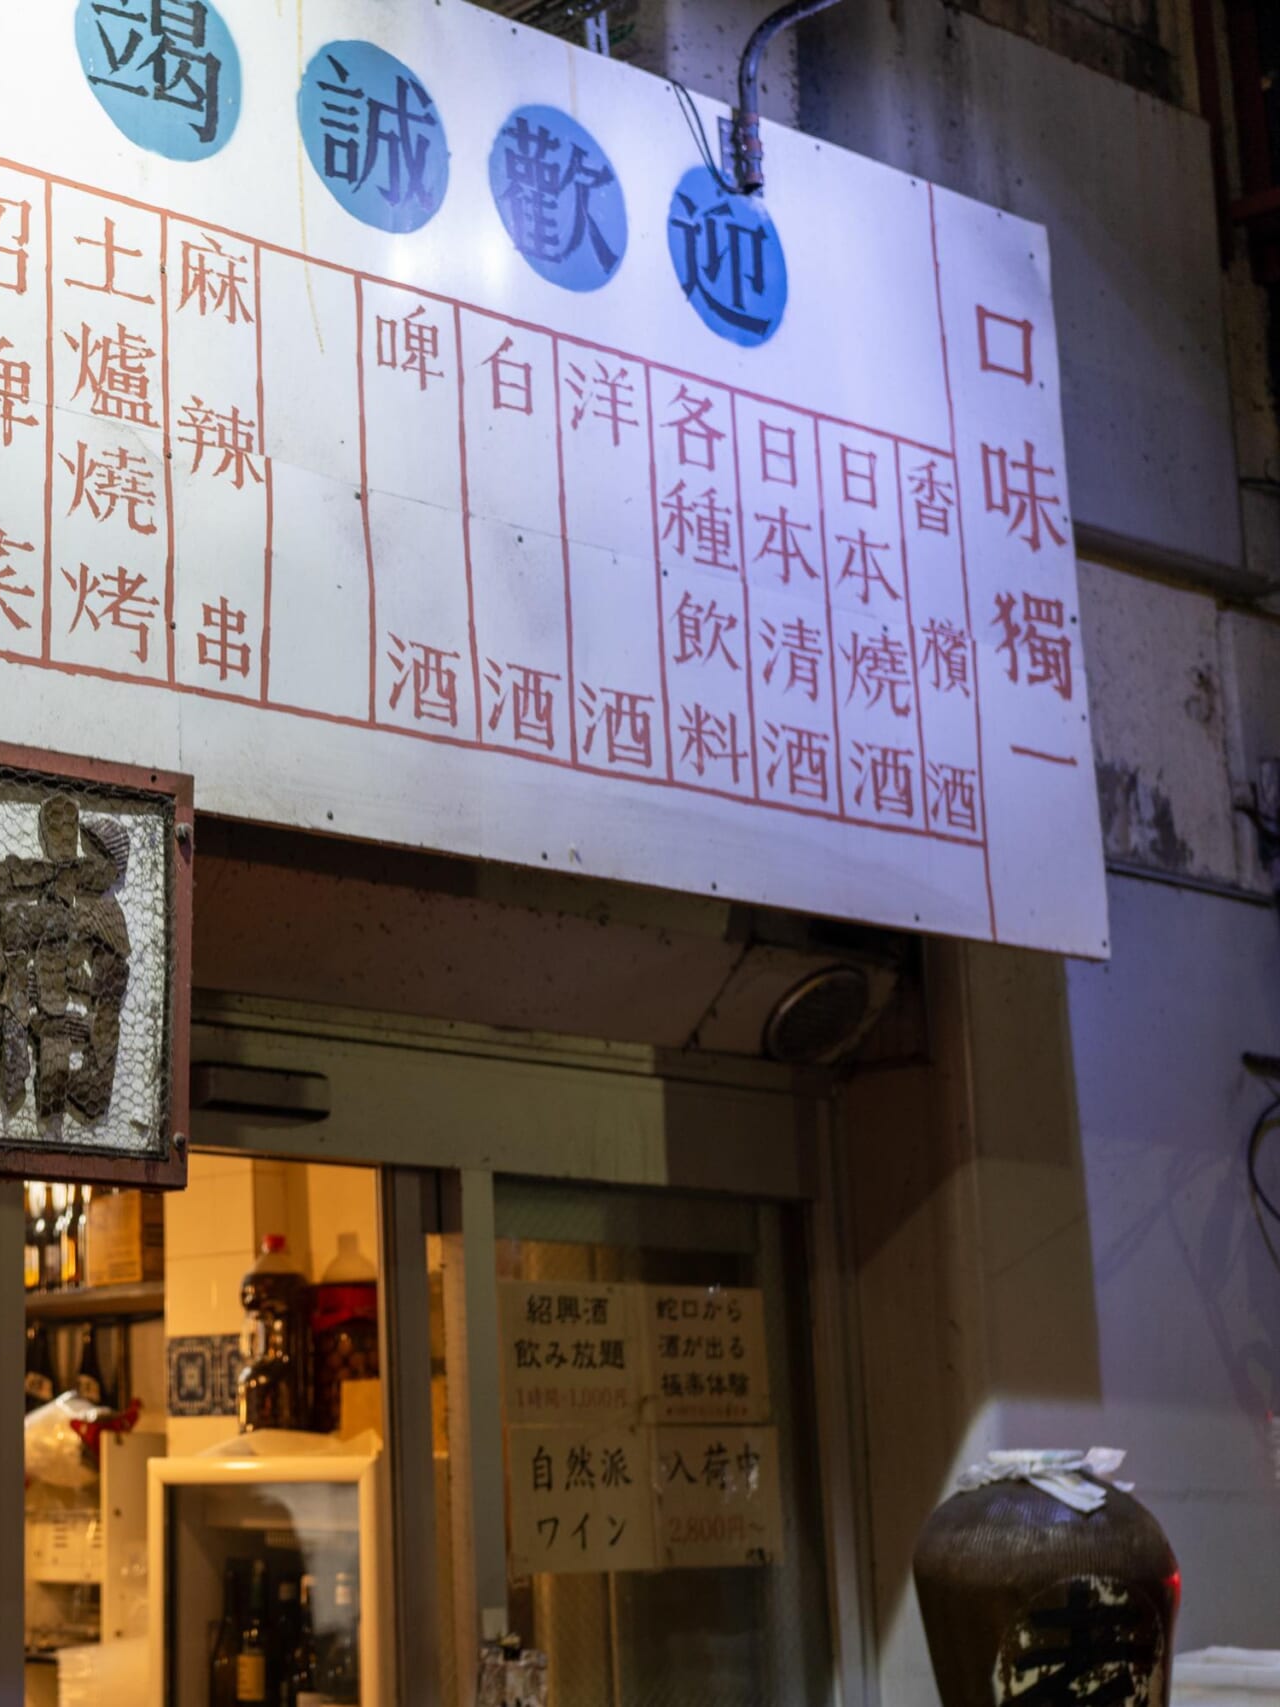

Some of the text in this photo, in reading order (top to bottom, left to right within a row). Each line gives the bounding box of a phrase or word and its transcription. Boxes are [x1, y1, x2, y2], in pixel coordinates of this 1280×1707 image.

[58, 217, 161, 664] 土爐燒烤
[176, 233, 265, 681] 麻辣串
[376, 305, 462, 728] 啤酒
[482, 336, 562, 751] 白酒
[567, 361, 654, 768] 洋酒
[663, 384, 749, 784] 各種飲料
[754, 420, 830, 802] 日本清酒
[835, 443, 914, 818] 日本燒酒
[975, 304, 1077, 766] 口味獨一
[910, 459, 977, 832] 香檳酒
[514, 1340, 625, 1370] 飲み放題
[526, 1295, 608, 1325] 紹興酒
[532, 1446, 632, 1492] 自然派
[536, 1513, 626, 1550] ワイン
